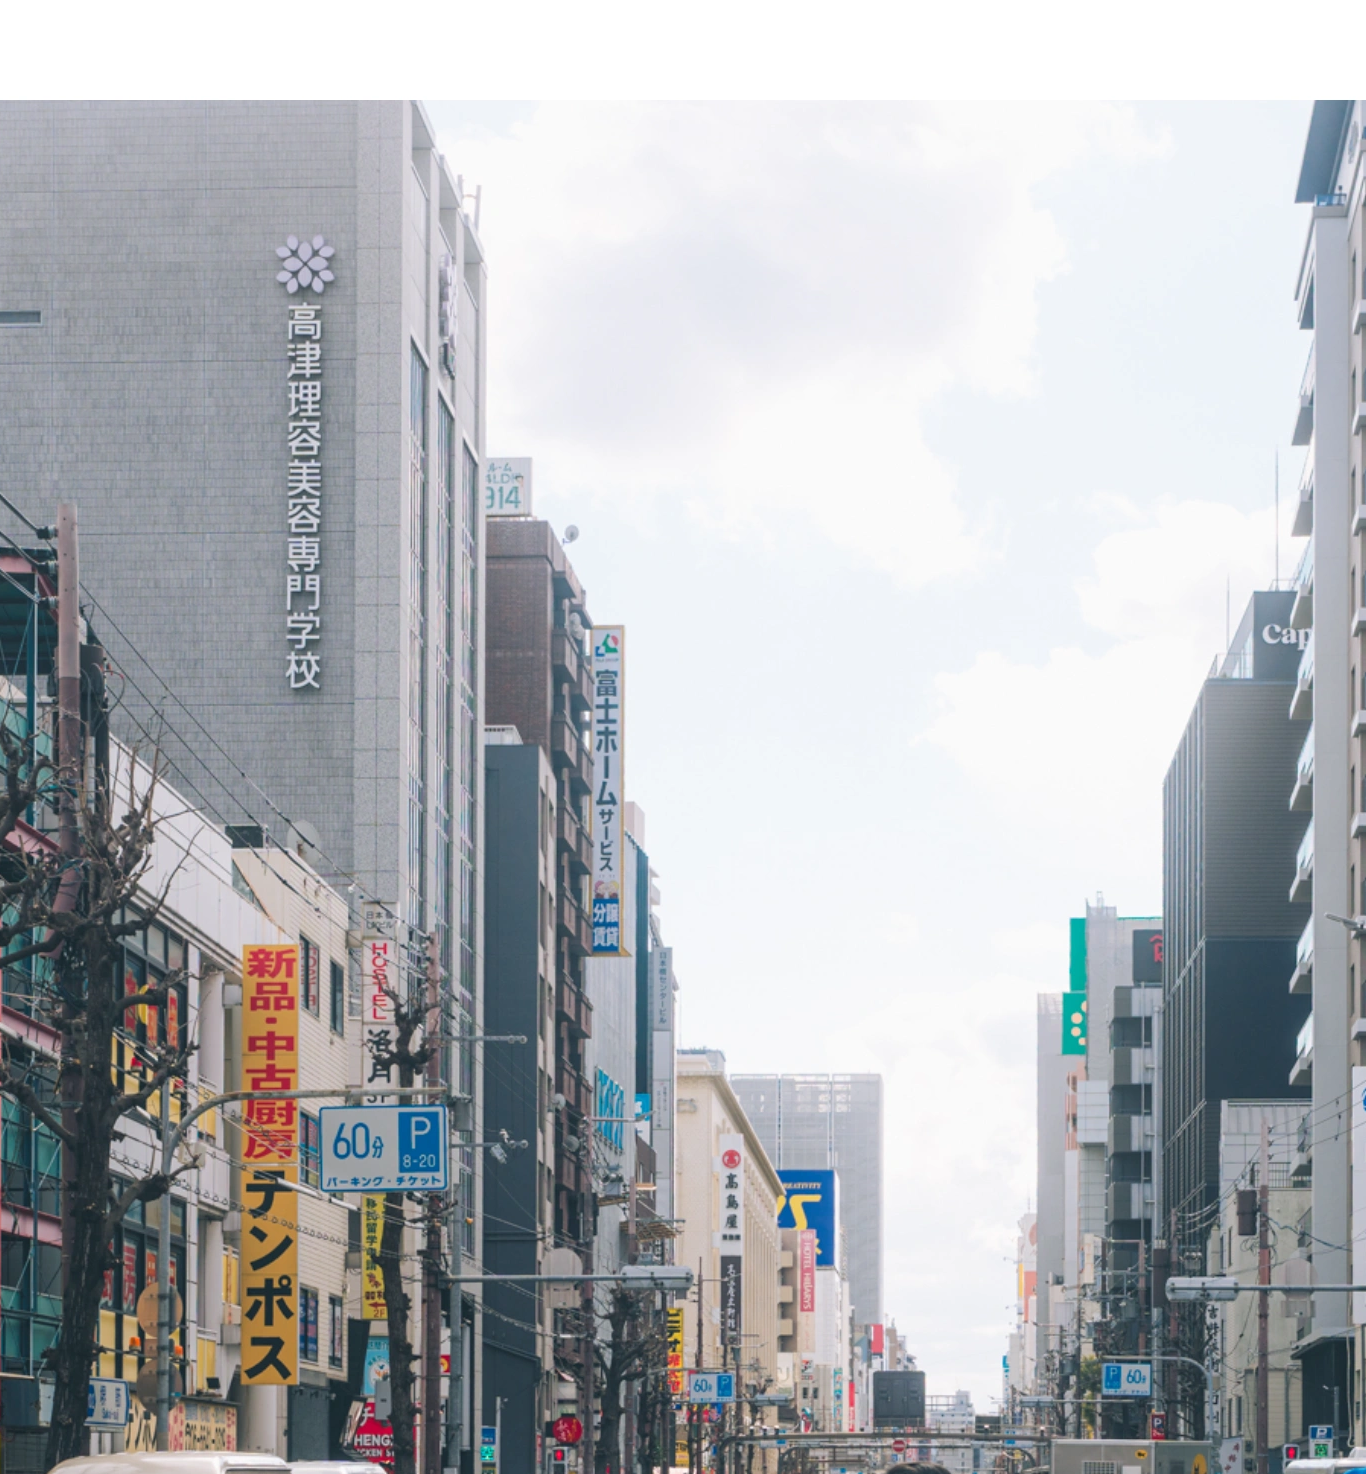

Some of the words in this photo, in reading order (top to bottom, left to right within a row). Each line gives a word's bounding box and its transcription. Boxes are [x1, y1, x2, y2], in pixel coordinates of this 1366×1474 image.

[286, 301, 322, 690] 高津理容美容専門学校
[595, 669, 620, 872] 富士ホームサービス
[593, 903, 620, 924] 分譲
[593, 925, 620, 947] 賃貸
[371, 943, 388, 1021] HOSTEL
[332, 1122, 385, 1160] 60分
[411, 1116, 432, 1150] P
[402, 1154, 438, 1169] 8-20
[325, 1175, 442, 1188] パーキング・チケット
[242, 1169, 295, 1382] テンポス
